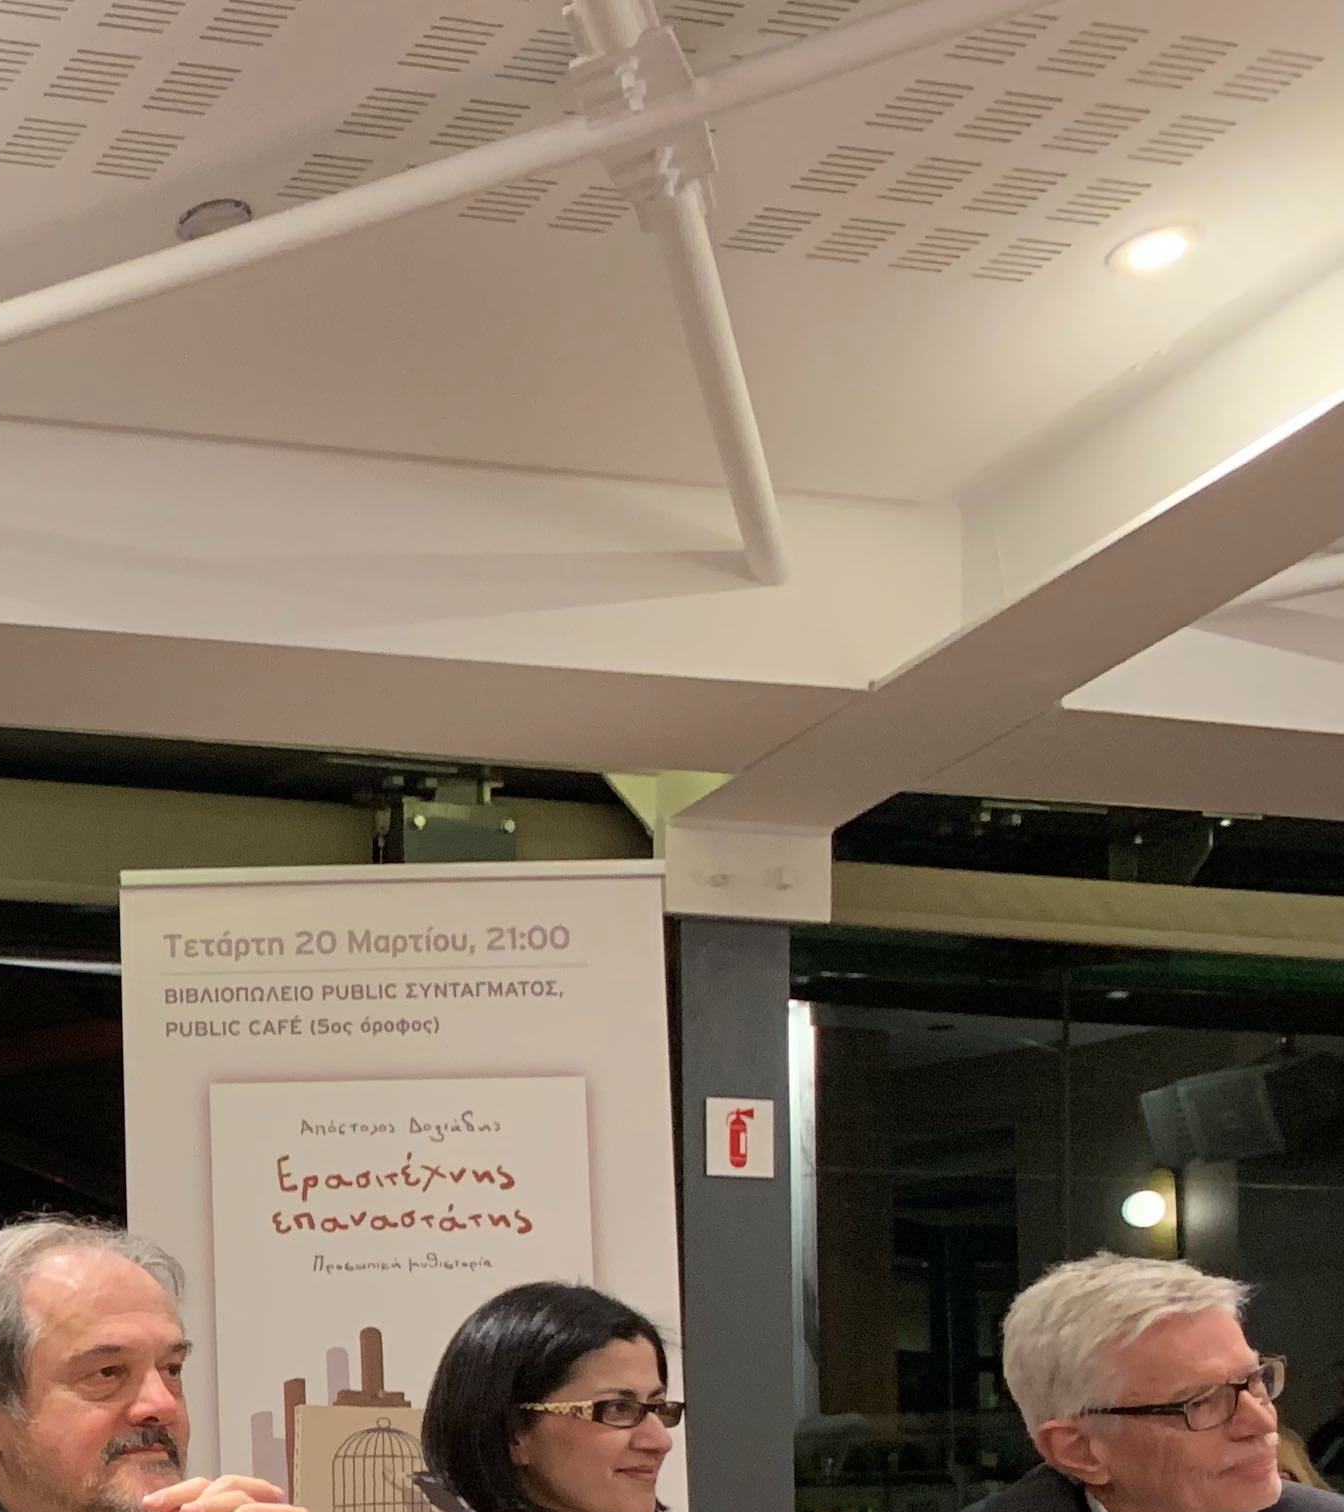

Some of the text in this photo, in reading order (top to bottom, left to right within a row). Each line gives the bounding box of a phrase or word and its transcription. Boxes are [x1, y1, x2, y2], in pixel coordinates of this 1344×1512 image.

[163, 924, 571, 961] Τετάρτη 20 Μαρτίου, 21:00
[164, 980, 564, 1004] ΒΙΒΛΙΟΠΩΛΕΙΟ PUBLIC ΣΥΝΤΑΓΜΑΤΟΣ,
[165, 1020, 241, 1037] PUBLIC
[247, 1015, 303, 1036] CAFÉ
